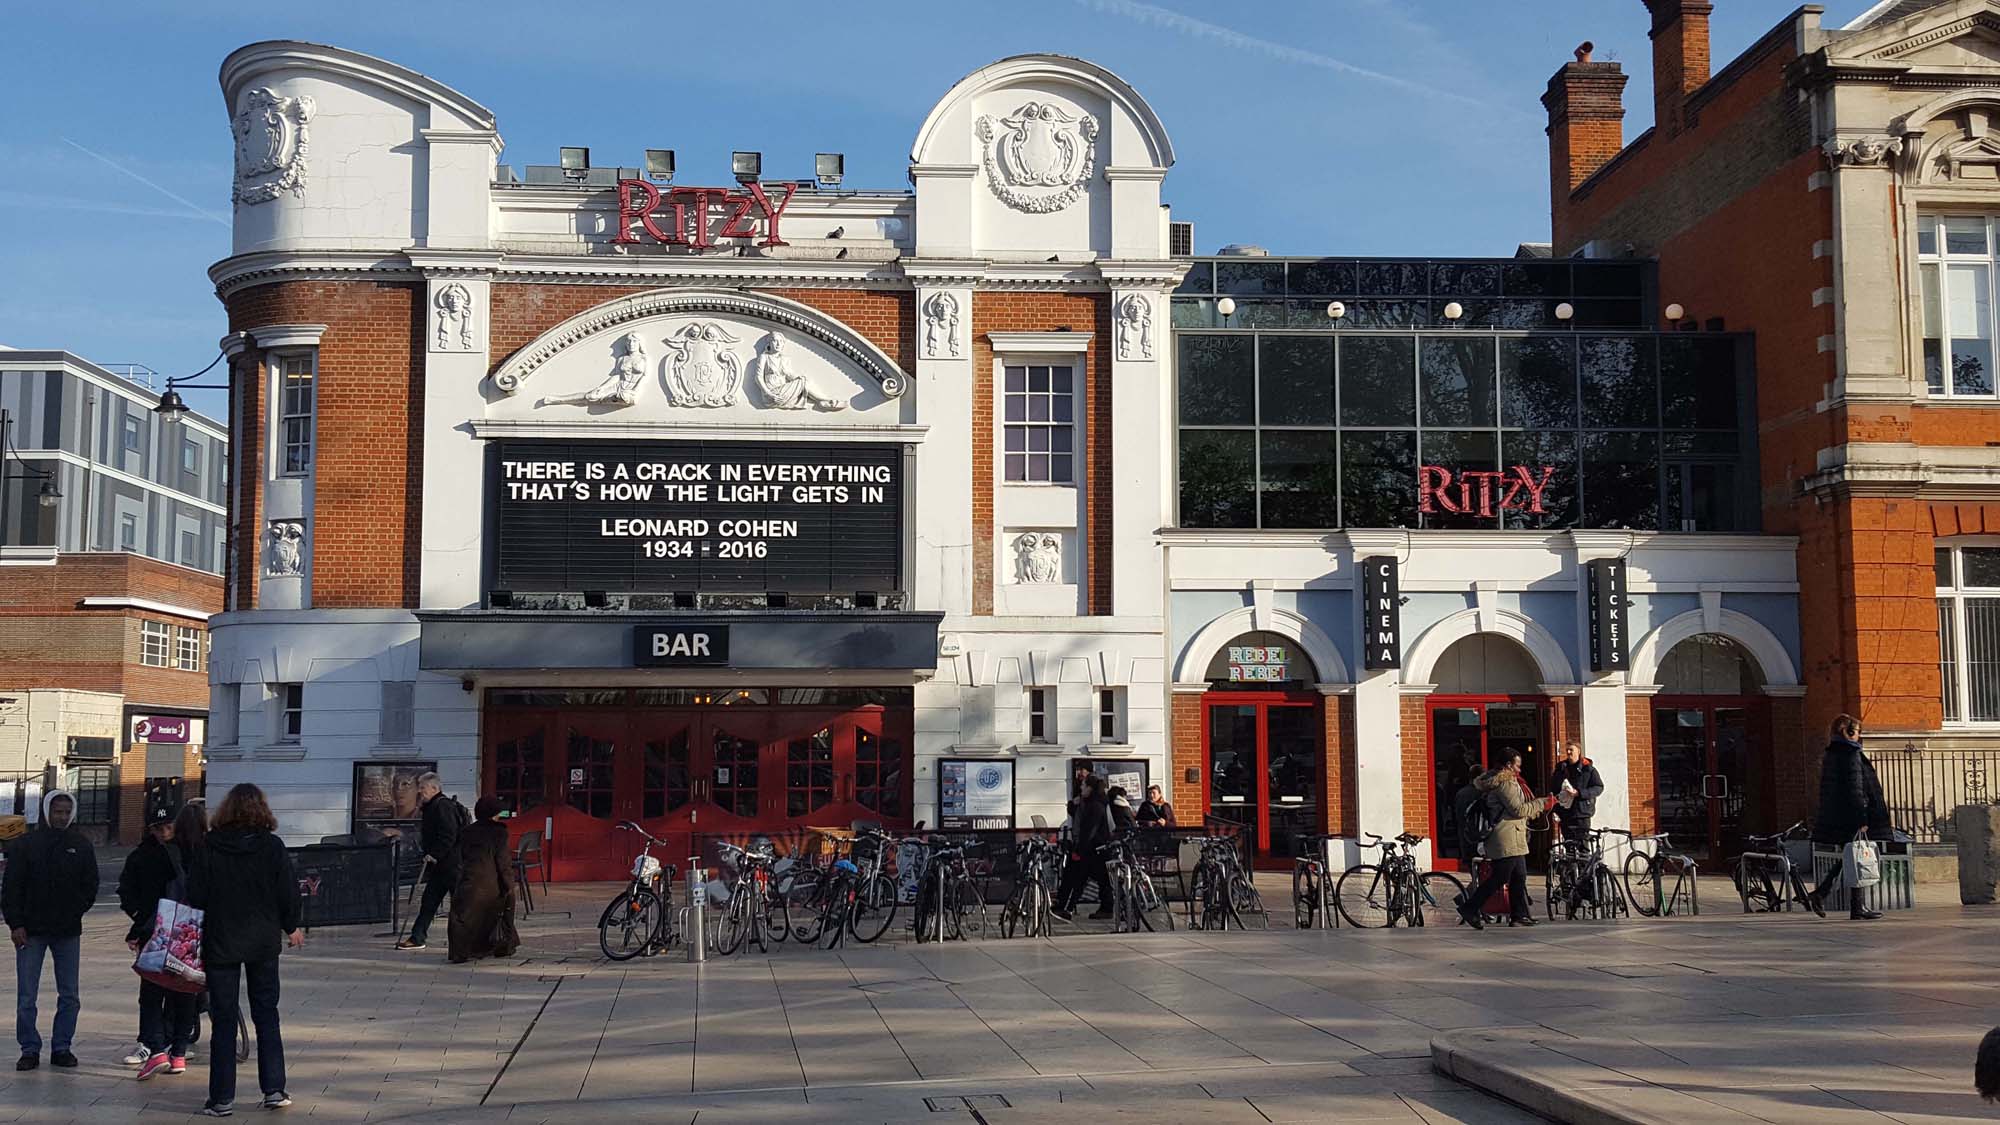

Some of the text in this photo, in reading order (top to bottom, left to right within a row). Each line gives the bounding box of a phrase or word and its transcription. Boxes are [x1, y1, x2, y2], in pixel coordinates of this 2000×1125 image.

[609, 178, 799, 250] RITZY
[502, 461, 891, 483] THERE IS A CRACK IN EVERYTHING
[507, 480, 883, 504] THAT'S HOW THE LIGHT GETS IN
[1417, 465, 1554, 518] RITZY
[601, 518, 798, 538] LEONARD COHEN
[642, 540, 694, 558] 1934
[718, 540, 768, 559] 2016
[1379, 564, 1394, 661] CINEMA
[1608, 566, 1620, 663] TICKETS
[653, 633, 710, 656] BAR
[1228, 646, 1291, 664] REBEL
[1228, 663, 1292, 683] REBEL
[972, 818, 1009, 830] LONDON
